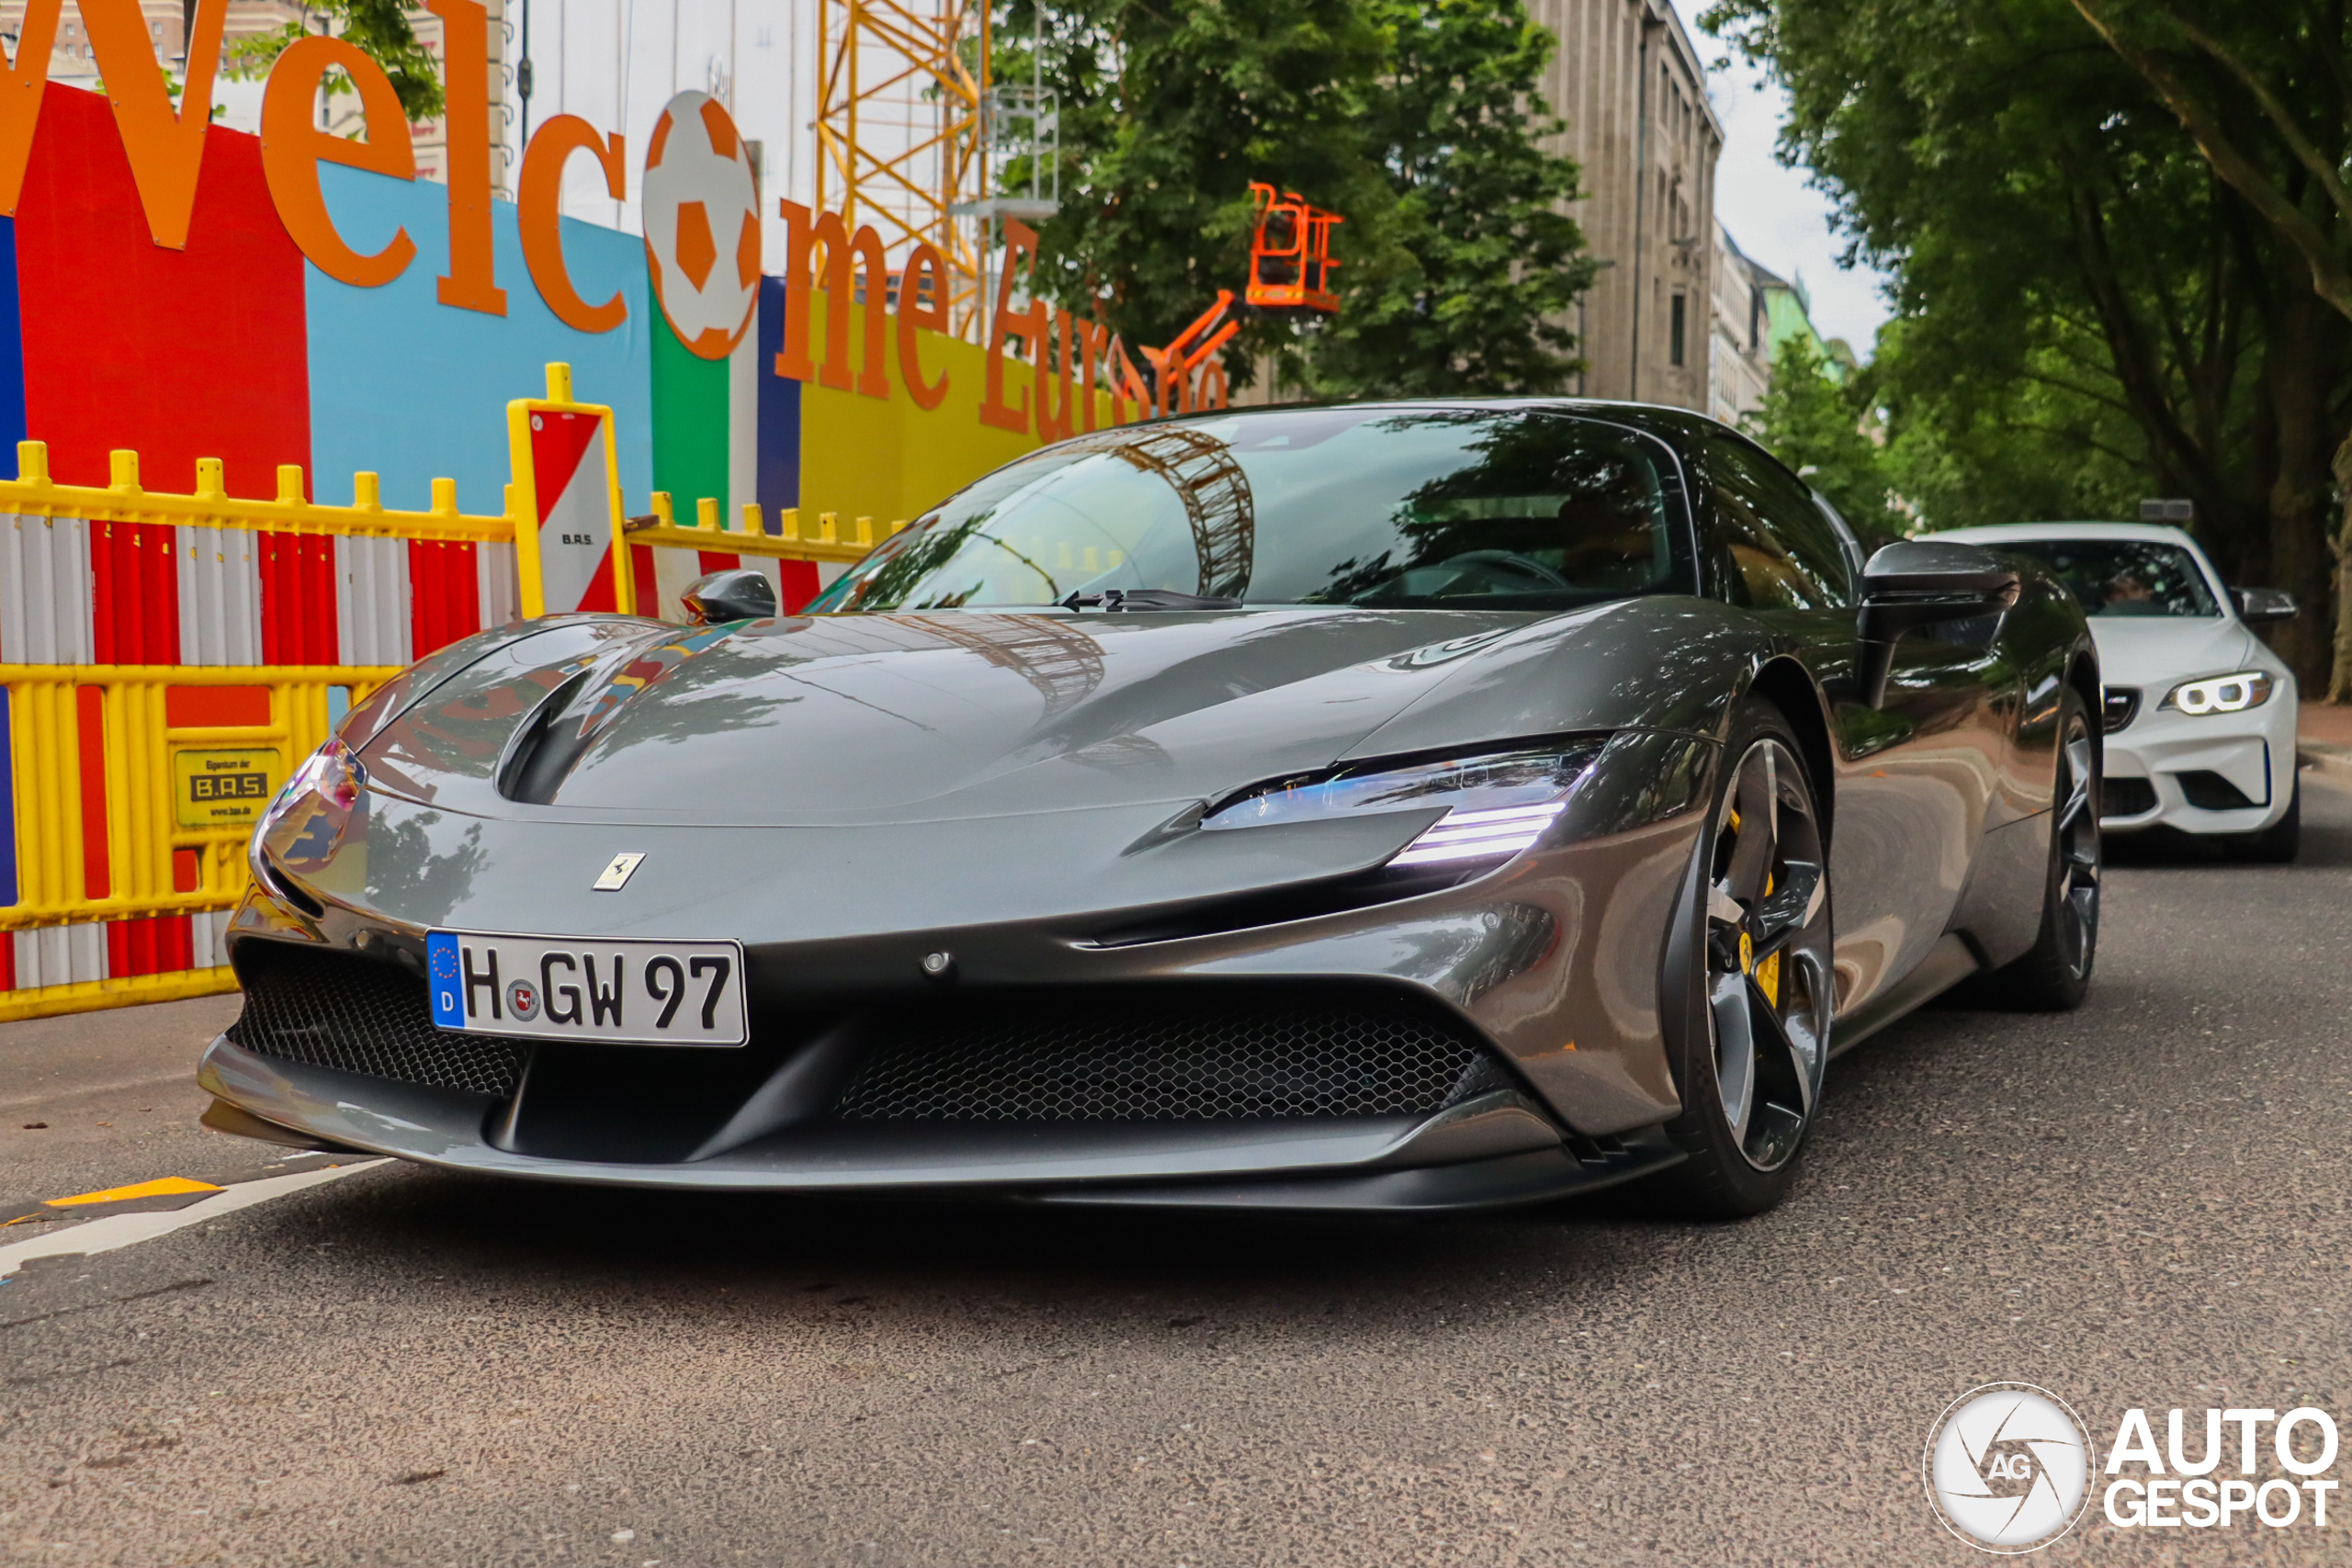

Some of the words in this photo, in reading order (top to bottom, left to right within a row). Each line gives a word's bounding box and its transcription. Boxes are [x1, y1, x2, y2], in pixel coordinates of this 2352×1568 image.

[561, 534, 594, 546] B.A.S.
[206, 761, 238, 771] Eigentum
[240, 760, 251, 769] der
[196, 776, 266, 797] B.A.S.
[462, 945, 502, 1020] H
[539, 952, 624, 1027] GW
[644, 954, 731, 1029] 97
[441, 991, 455, 1012] D
